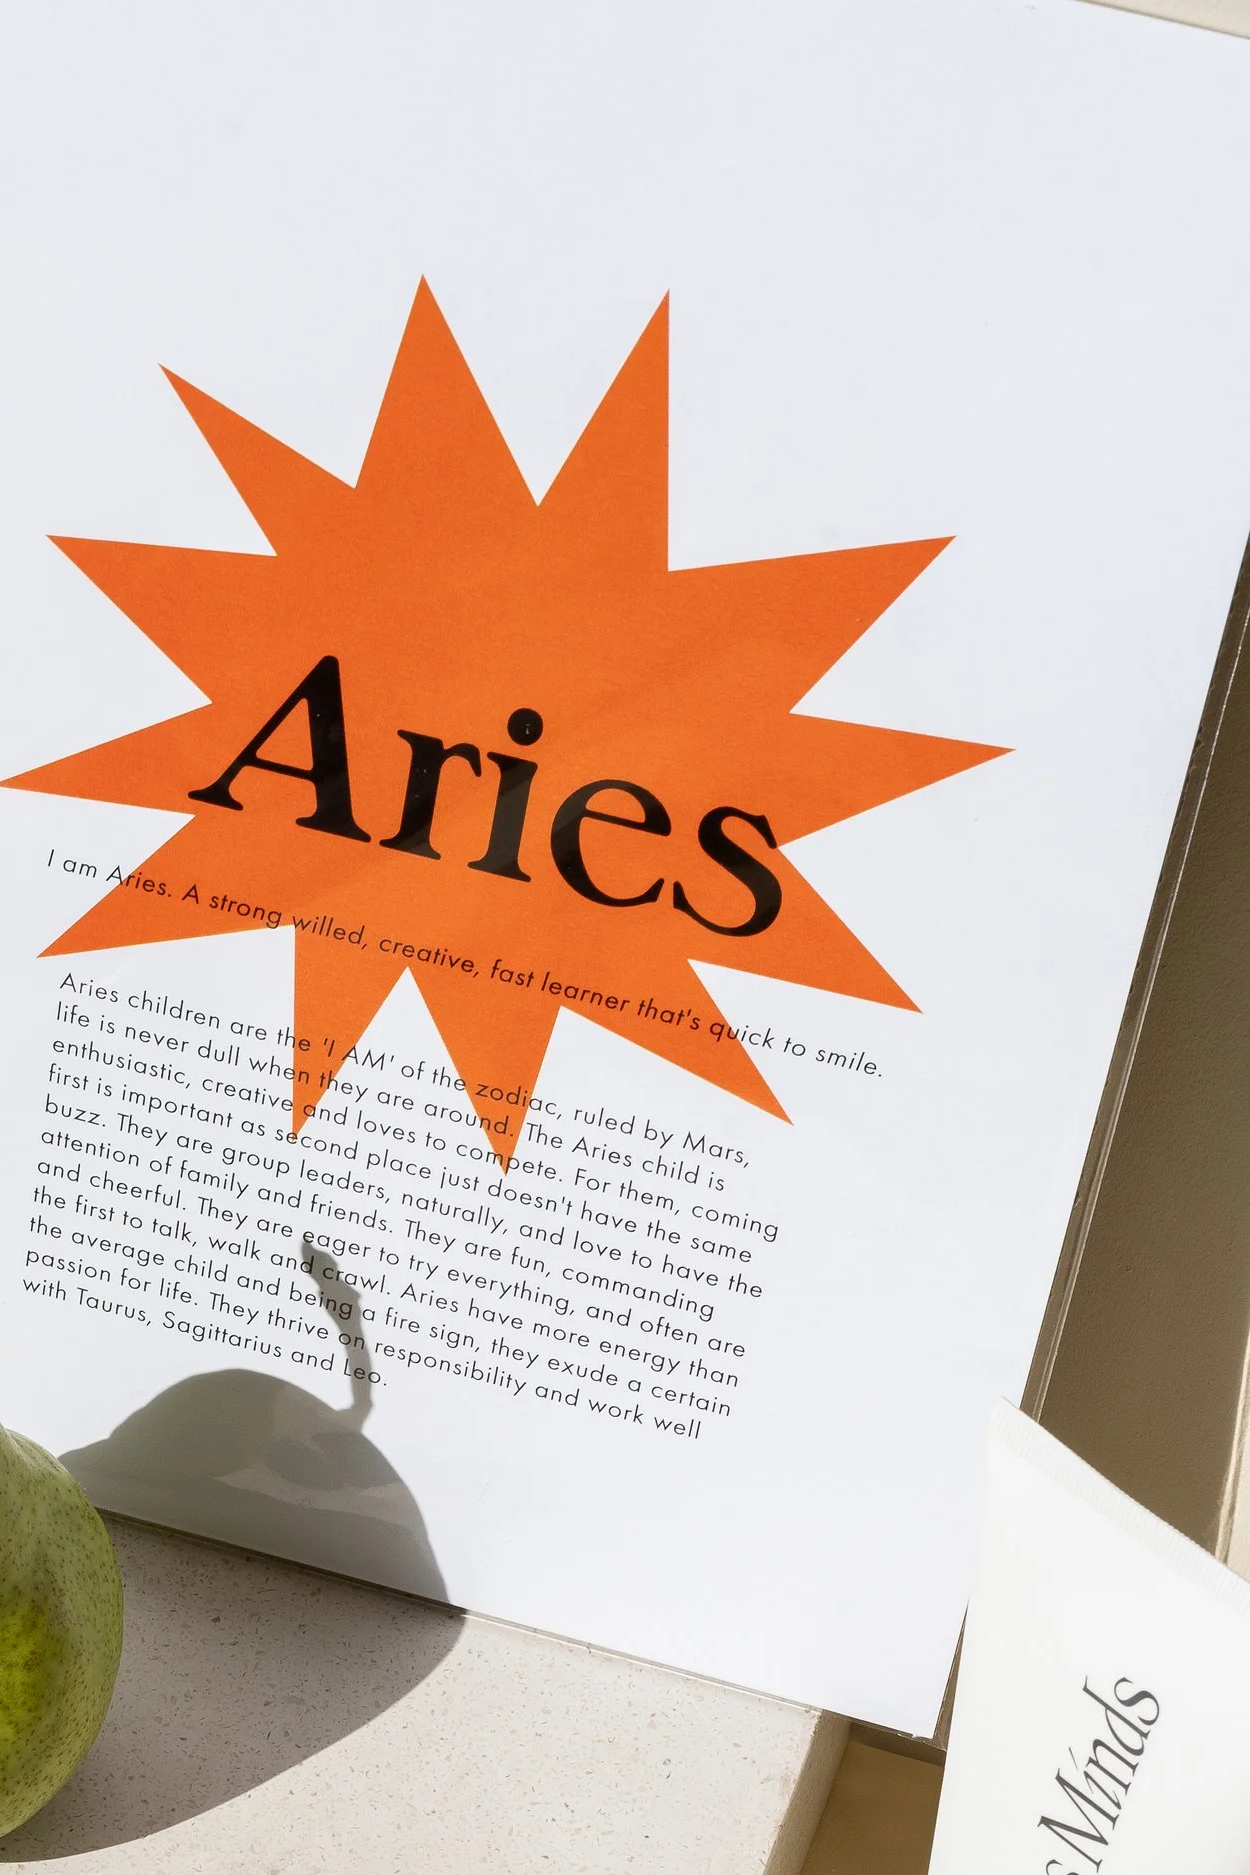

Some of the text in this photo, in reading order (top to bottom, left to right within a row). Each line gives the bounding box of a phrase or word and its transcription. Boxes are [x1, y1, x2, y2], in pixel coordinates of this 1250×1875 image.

[188, 655, 782, 936] Aries
[47, 848, 881, 1077] I am Aries. A strong willed, creative, fast learner that's quick to smile.
[48, 1062, 751, 1262] first is important as second place just doesn't have the same
[52, 1040, 778, 1242] enthusiastic, creative and loves to compete. For them, coming
[56, 1000, 724, 1191] life is never dull when they are around. The Aries child is
[59, 972, 118, 1002] Aries
[127, 990, 219, 1029] children
[230, 1021, 266, 1040] are
[277, 1026, 310, 1051] the
[400, 1060, 425, 1080] of
[432, 1066, 466, 1091] the
[475, 1083, 561, 1119] zodiac,
[573, 1107, 635, 1135] ruled
[643, 1119, 673, 1149] by
[682, 1131, 748, 1168] Mars,
[33, 1185, 738, 1387] the first to talk, walk and crawl. Aries have more energy than
[37, 1161, 745, 1357] and cheerful. They are eager to try everything, and often are
[41, 1131, 714, 1322] attention of family and friends. They are fun, commanding
[45, 1092, 762, 1297] buzz. They are group leaders, naturally, and love to have the
[22, 1278, 387, 1386] with Taurus, Sagittarius and Leo.
[25, 1250, 701, 1439] passion for life. They thrive on responsibility and work well
